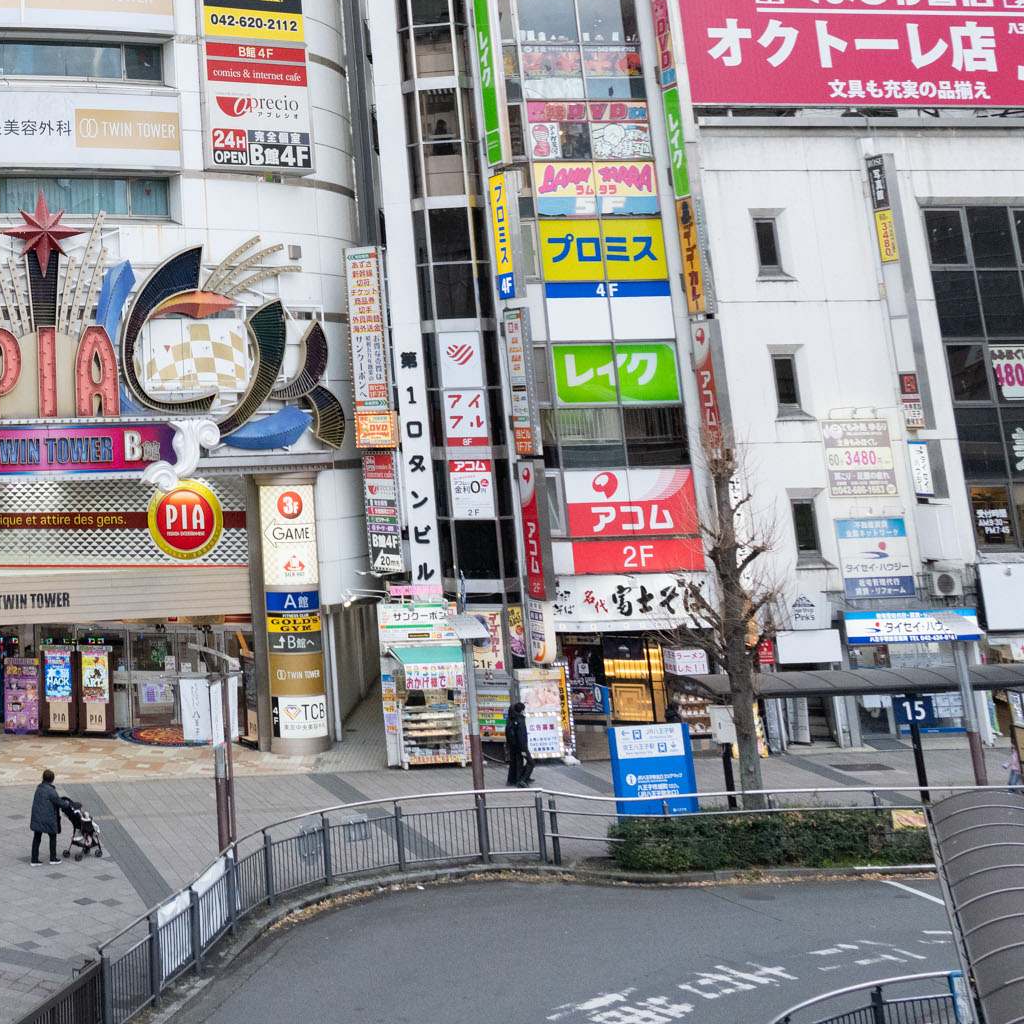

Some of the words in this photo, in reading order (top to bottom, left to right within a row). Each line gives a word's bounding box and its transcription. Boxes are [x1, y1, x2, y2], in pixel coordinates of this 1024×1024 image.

[210, 14, 298, 32] 042-620-2112
[707, 18, 998, 72] オクトーレ店
[479, 32, 491, 87] レイク
[213, 68, 241, 78] comics
[243, 69, 250, 78] &
[253, 70, 283, 81] internet
[285, 72, 301, 82] cafe
[828, 79, 991, 100] 文具も充実の品揃え
[234, 95, 299, 114] aprecio
[102, 121, 132, 137] TWIN
[137, 122, 176, 139] TOWER
[255, 131, 301, 144] 完全個室
[214, 130, 246, 148] 24H
[668, 114, 682, 169] レイク
[215, 150, 246, 164] OPEN
[250, 144, 308, 166] B館4F
[494, 182, 509, 264] プロミス
[548, 233, 658, 263] プロミス
[501, 277, 513, 294] 4F
[596, 283, 619, 297] 4F
[565, 353, 657, 387] レイク
[700, 371, 719, 426] アコム
[43, 436, 114, 463] TOWER
[462, 438, 472, 446] 8F
[454, 461, 486, 472] アコム
[282, 496, 299, 514] 3F
[467, 508, 480, 516] 2F
[25, 516, 37, 525] et
[40, 514, 71, 525] attire
[73, 514, 93, 525] des
[97, 516, 126, 528] gens.
[166, 504, 205, 530] PIA
[591, 505, 674, 532] アコム
[272, 526, 310, 540] GAME
[527, 522, 540, 574] アコム
[623, 545, 654, 568] 2F
[532, 582, 541, 593] 2F
[31, 592, 69, 609] TOWER
[284, 594, 309, 608] A館
[271, 617, 318, 625] GOLD'S
[795, 613, 816, 621] Pink's
[287, 635, 315, 649] B館へ
[287, 672, 303, 680] TWIN
[304, 670, 320, 678] TOWER
[53, 713, 66, 721] PIA
[89, 714, 103, 722] PIA
[301, 703, 325, 720] TCB
[902, 701, 926, 720] 15
